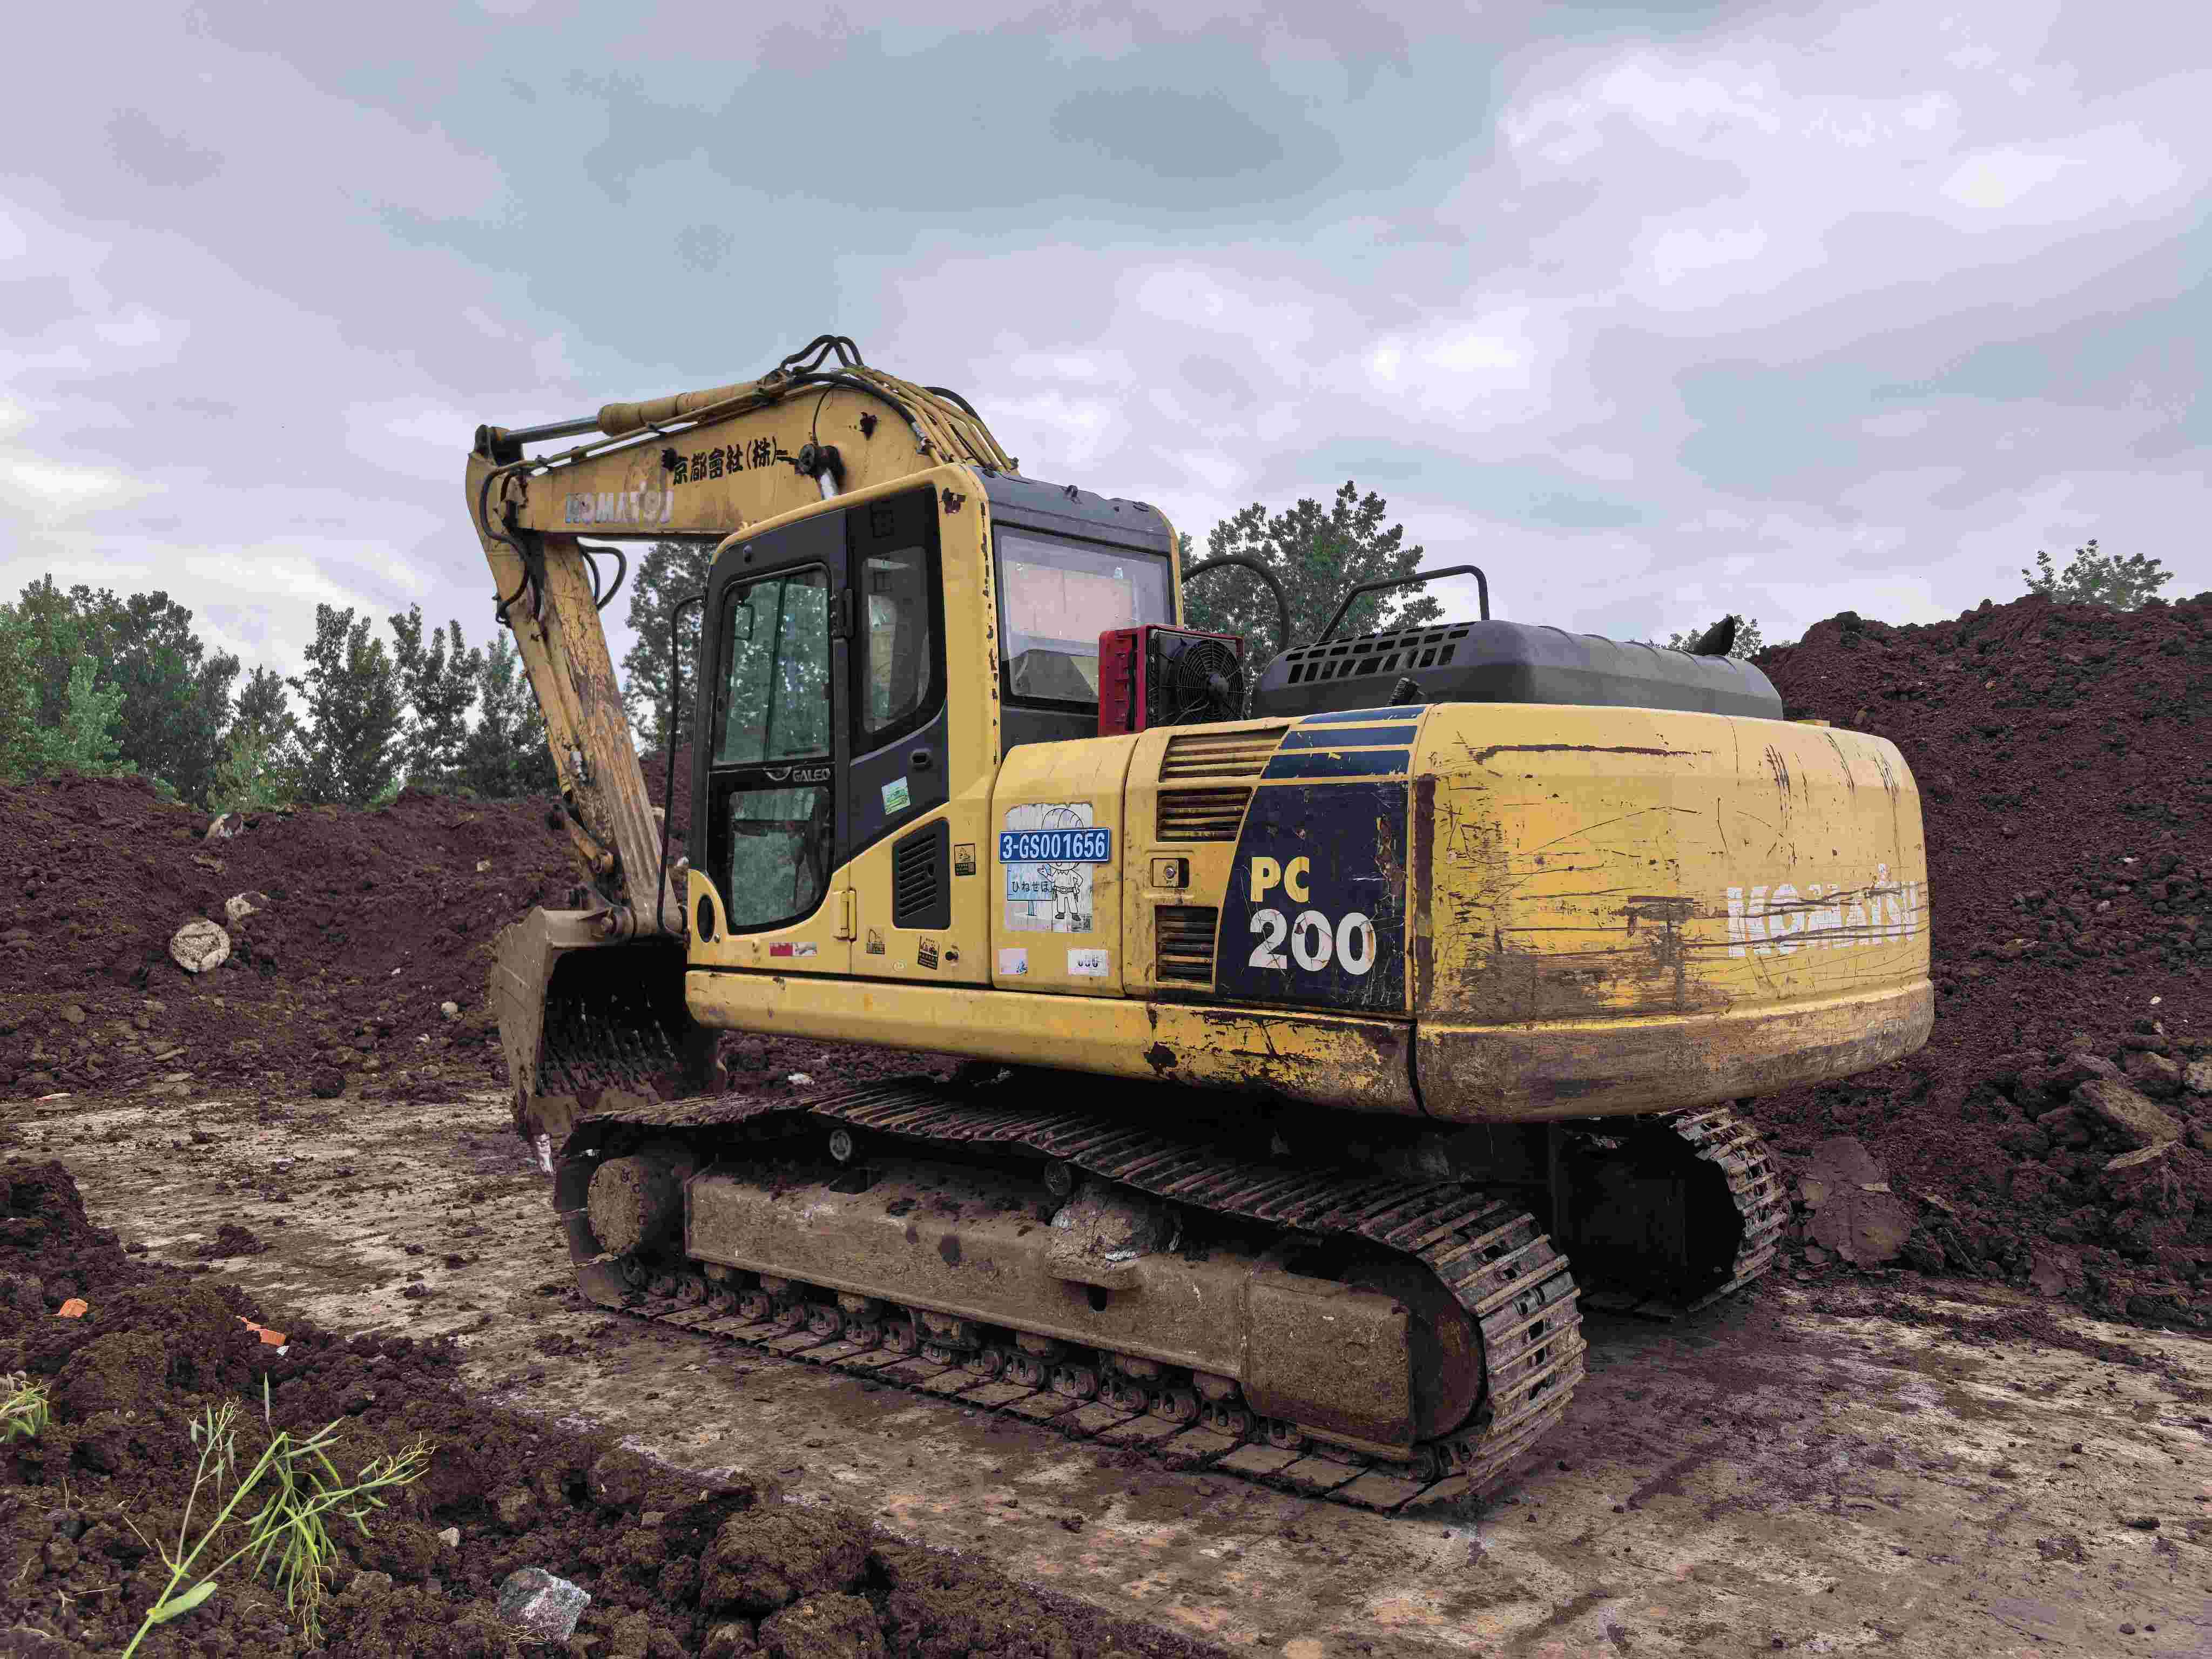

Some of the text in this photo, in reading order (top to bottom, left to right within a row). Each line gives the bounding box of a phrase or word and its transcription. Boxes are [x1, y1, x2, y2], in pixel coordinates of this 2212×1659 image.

[1002, 832, 1105, 859] 3-GS001656
[1250, 856, 1310, 902] PC
[1248, 908, 1377, 975] 200
